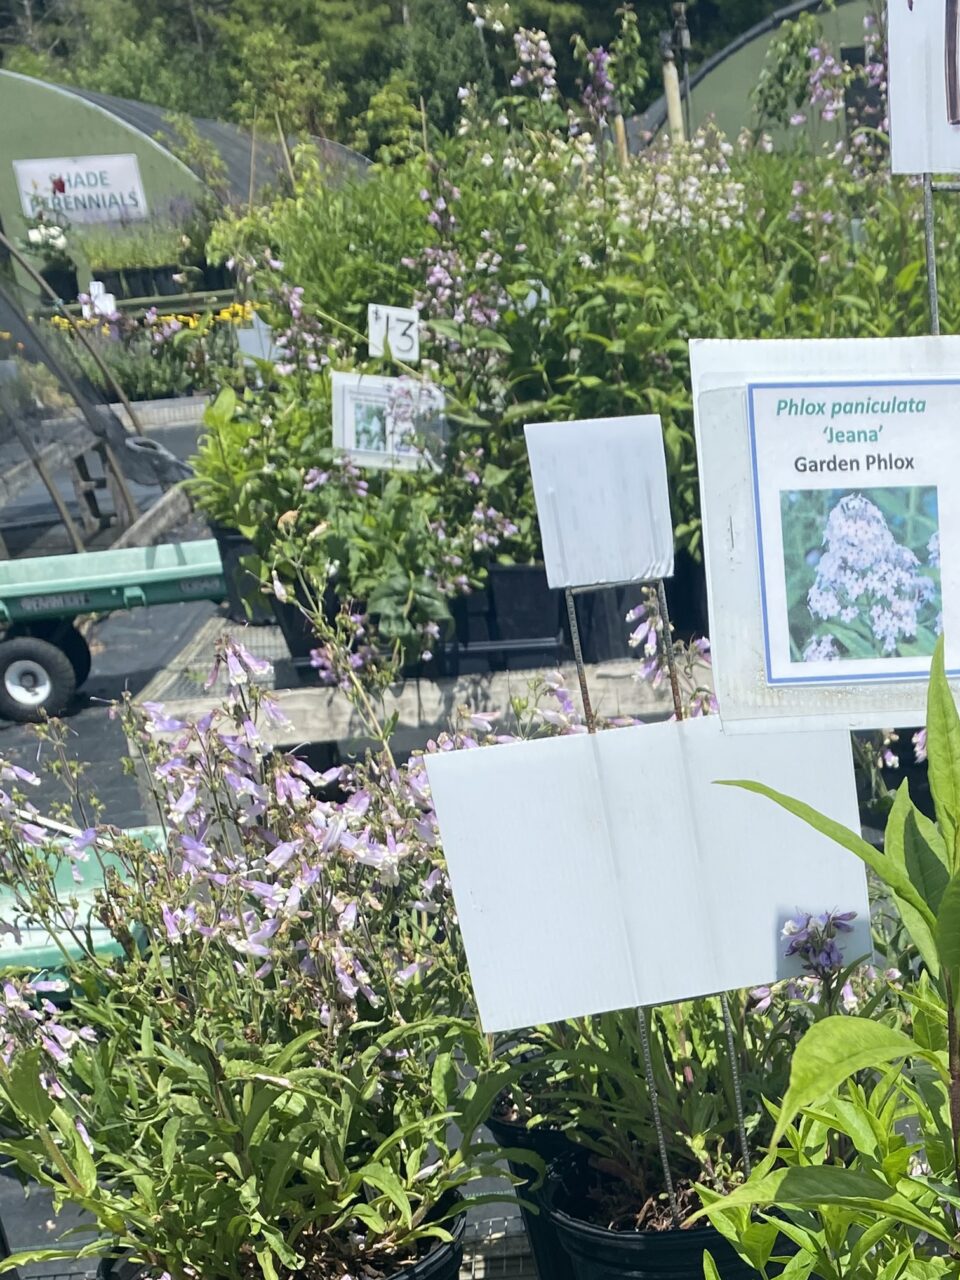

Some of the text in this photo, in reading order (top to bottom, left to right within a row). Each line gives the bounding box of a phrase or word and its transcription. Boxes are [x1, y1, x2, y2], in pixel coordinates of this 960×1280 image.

[776, 396, 927, 418] Phlox paniculata
[823, 425, 883, 444] ‘Jeana’
[794, 453, 915, 473] Garden Phlox
